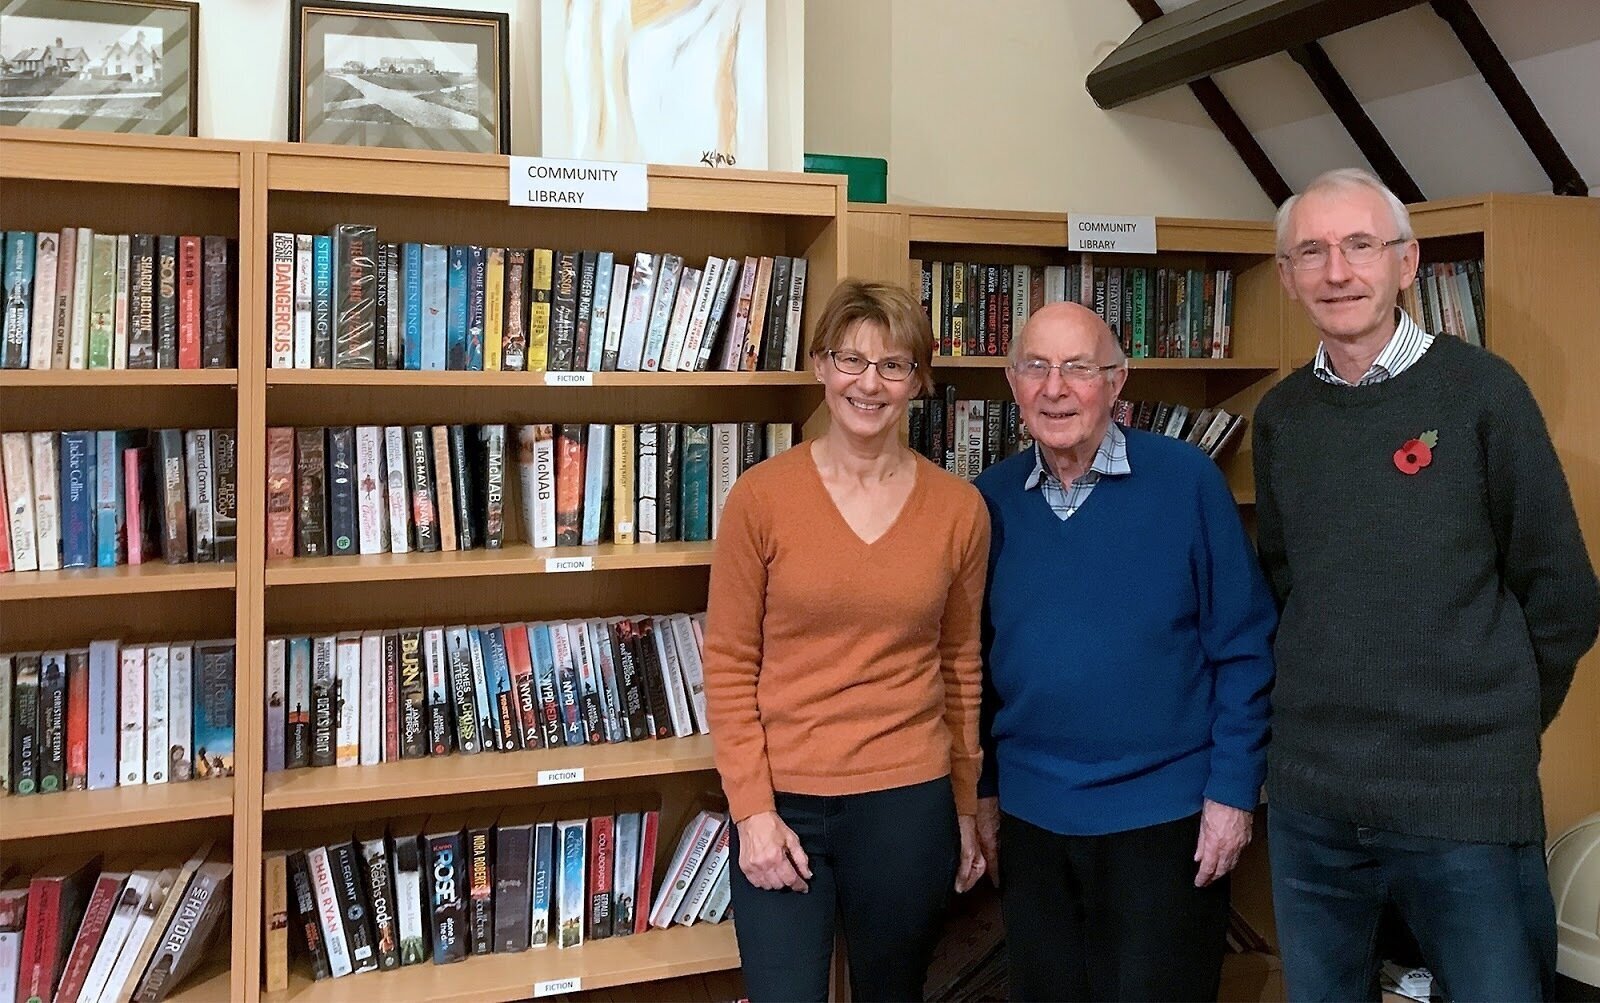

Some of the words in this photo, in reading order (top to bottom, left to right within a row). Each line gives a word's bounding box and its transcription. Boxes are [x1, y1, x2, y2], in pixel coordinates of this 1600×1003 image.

[528, 165, 618, 182] COMMUNITY
[528, 190, 584, 204] LIBRARY
[1078, 222, 1137, 233] COMMUNITY
[275, 236, 284, 262] KEANE
[283, 236, 292, 262] JESSIE
[1079, 239, 1116, 250] LIBRARY
[141, 256, 152, 293] SHARON
[317, 242, 329, 297] STEPHEN
[378, 244, 387, 283] STEPHEN
[408, 250, 418, 301] STEPHEN
[475, 262, 485, 288] SOPHIE
[560, 255, 574, 295] LARSSON
[581, 262, 596, 296] TRIGGER
[1016, 271, 1024, 287] TANA
[377, 284, 387, 306] KING
[791, 276, 804, 312] Mankell
[955, 280, 963, 299] Colfer
[987, 267, 996, 293] DEAVER
[1135, 270, 1143, 301] PETER
[141, 296, 152, 331] BOLTON
[275, 263, 292, 353] DANGEROUS
[316, 300, 328, 332] KING
[475, 290, 484, 326] KINSELLA
[1001, 306, 1009, 322] KILL
[1016, 289, 1024, 317] FRENCH
[1109, 285, 1118, 323] HAYDER
[1135, 302, 1143, 335] JAMES
[8, 307, 16, 343] BARCLAY
[15, 308, 24, 344] LINWOOD
[58, 328, 64, 338] OF
[132, 314, 140, 334] LIES
[378, 315, 386, 350] CARRIE
[407, 304, 417, 335] KING
[720, 430, 730, 455] JOJO
[969, 434, 981, 446] JO
[988, 408, 1001, 452] NESSER
[68, 438, 84, 469] Jackie
[196, 434, 209, 470] Bernard
[368, 440, 376, 465] Carole
[387, 430, 397, 467] Matthews
[413, 431, 426, 465] PETER
[946, 449, 955, 459] JO
[957, 442, 967, 453] JO
[968, 448, 981, 476] NESBO
[417, 466, 427, 487] MAY
[488, 453, 502, 504] McNAB
[538, 451, 550, 501] McNAB
[721, 457, 730, 493] MOYES
[957, 454, 967, 477] NESBO
[70, 470, 84, 502] Collins
[197, 470, 210, 505] Cornwell
[226, 484, 236, 509] FLESH
[218, 488, 229, 516] BLOOD
[418, 490, 431, 539] RUNAWAY
[39, 503, 48, 539] COLGAN
[14, 519, 26, 561] COLGAN
[556, 561, 585, 569] FICTION
[317, 642, 326, 680] PATTERSON
[387, 640, 396, 662] TONY
[401, 637, 420, 687] BURN
[619, 643, 632, 687] PATTERSON
[624, 652, 636, 677] JAMES
[213, 654, 228, 683] KEN
[387, 665, 396, 703] PARSONS
[452, 651, 466, 705] PATTERSON
[460, 662, 472, 692] JAMES
[473, 652, 484, 685] PATTERSON
[214, 683, 229, 727] FOLLETT
[540, 678, 553, 702] NYPD
[630, 686, 641, 710] HOPE
[53, 690, 62, 729] CHRISTINE
[404, 699, 415, 743] PATTERSON
[411, 708, 421, 733] JAMES
[461, 702, 476, 740] CROSS
[519, 683, 533, 712] NYPD
[526, 728, 539, 741] 2
[545, 702, 558, 721] RED
[562, 681, 575, 706] NYPD
[569, 722, 580, 734] 4
[432, 707, 442, 742] PATTERSON
[503, 719, 512, 739] INDIA
[548, 720, 558, 734] 3
[22, 735, 32, 757] WILD
[53, 731, 61, 762] FEEHAN
[295, 740, 304, 759] north
[316, 728, 331, 753] LIGHT
[22, 759, 32, 776] CAT
[548, 771, 577, 781] FICTION
[473, 835, 486, 857] NORA
[565, 830, 575, 873] SCANLAN
[692, 837, 711, 857] ROSIE
[339, 849, 357, 901] ALLEGIANT
[432, 850, 456, 906] ROSE
[473, 857, 487, 889] ROBERTS
[597, 833, 607, 892] COLLABORATOR
[682, 858, 698, 879] EFFECT
[706, 855, 724, 876] cop
[190, 886, 208, 901] MO
[314, 854, 330, 895] CHRIS
[322, 897, 339, 934] RYAN
[369, 864, 386, 898] Reichs
[535, 869, 548, 906] twins
[691, 877, 709, 906] town
[374, 898, 393, 930] code
[593, 895, 601, 925] SEYMOUR
[600, 894, 609, 918] GERALD
[164, 898, 204, 953] HAYDER
[440, 923, 448, 934] the
[446, 918, 456, 940] alone
[144, 968, 168, 1001] WOLF
[545, 981, 573, 992] FICTION
